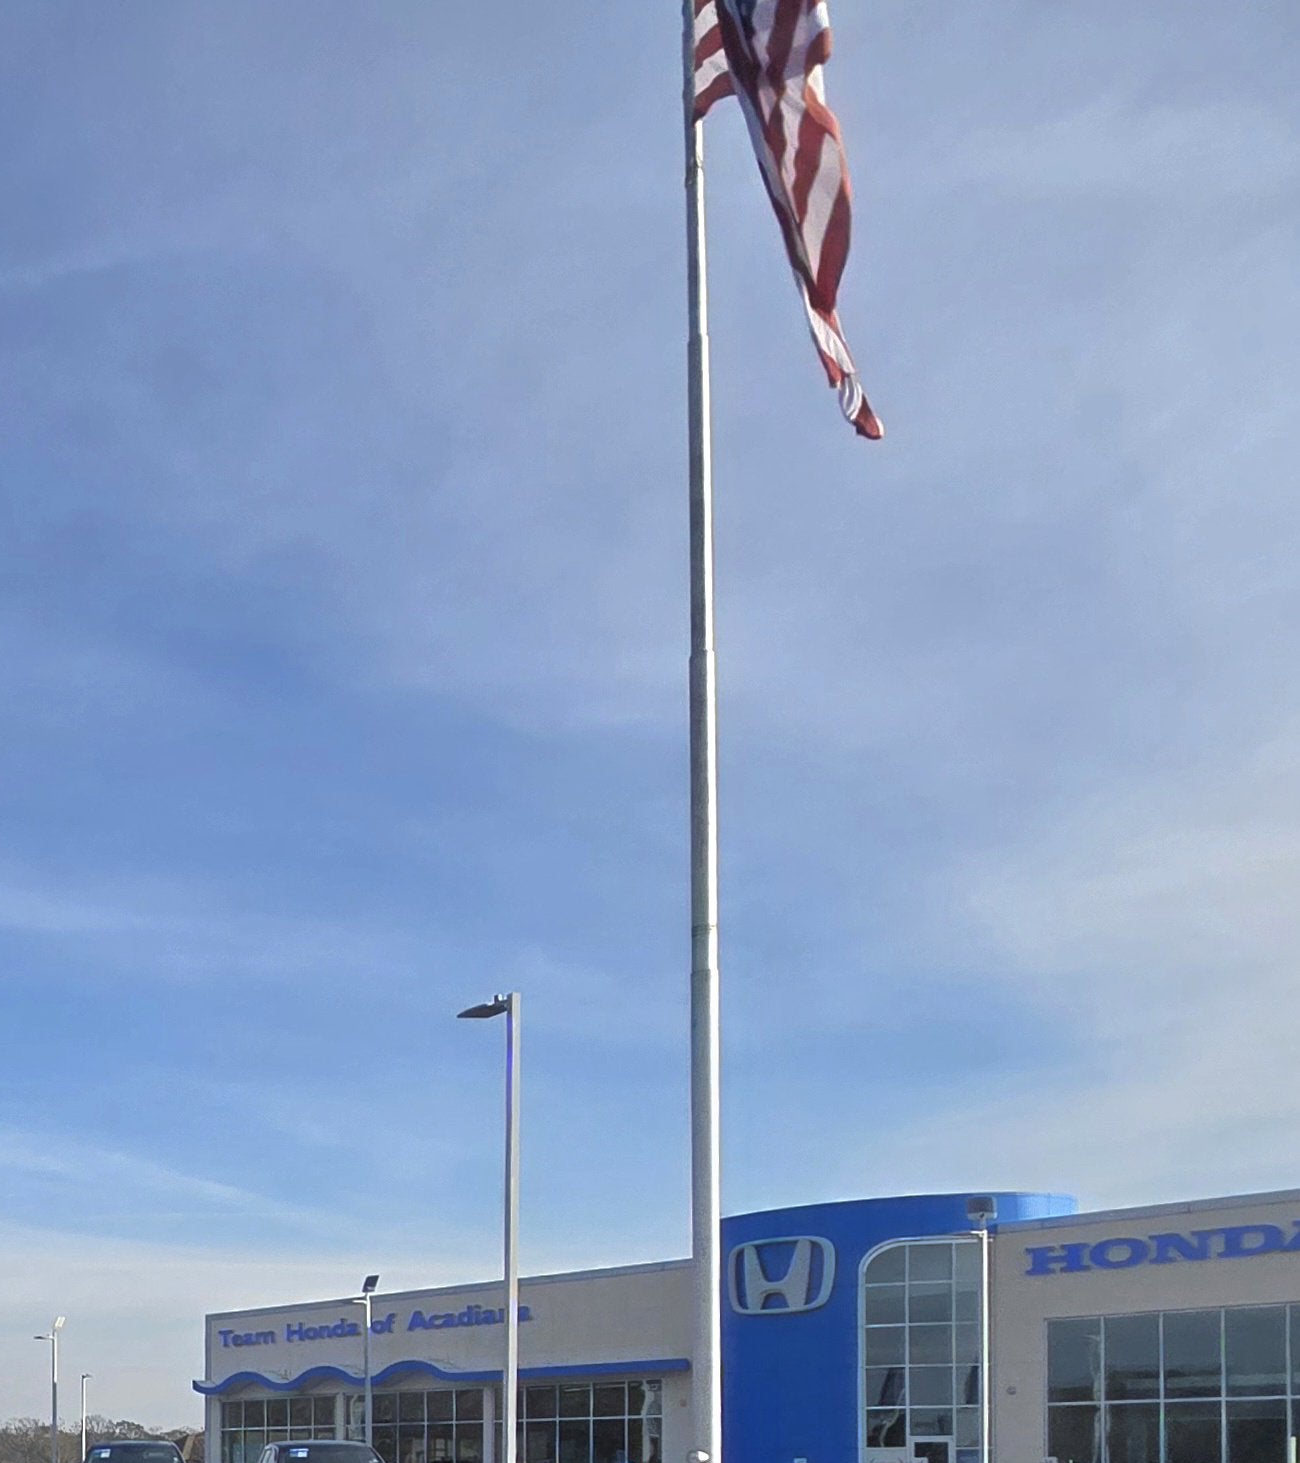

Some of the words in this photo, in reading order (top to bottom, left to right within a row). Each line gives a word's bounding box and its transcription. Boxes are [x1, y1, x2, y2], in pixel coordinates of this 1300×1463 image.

[1025, 1220, 1300, 1276] HOND
[218, 1328, 276, 1348] Team
[286, 1317, 362, 1342] Honda
[371, 1312, 397, 1334] of
